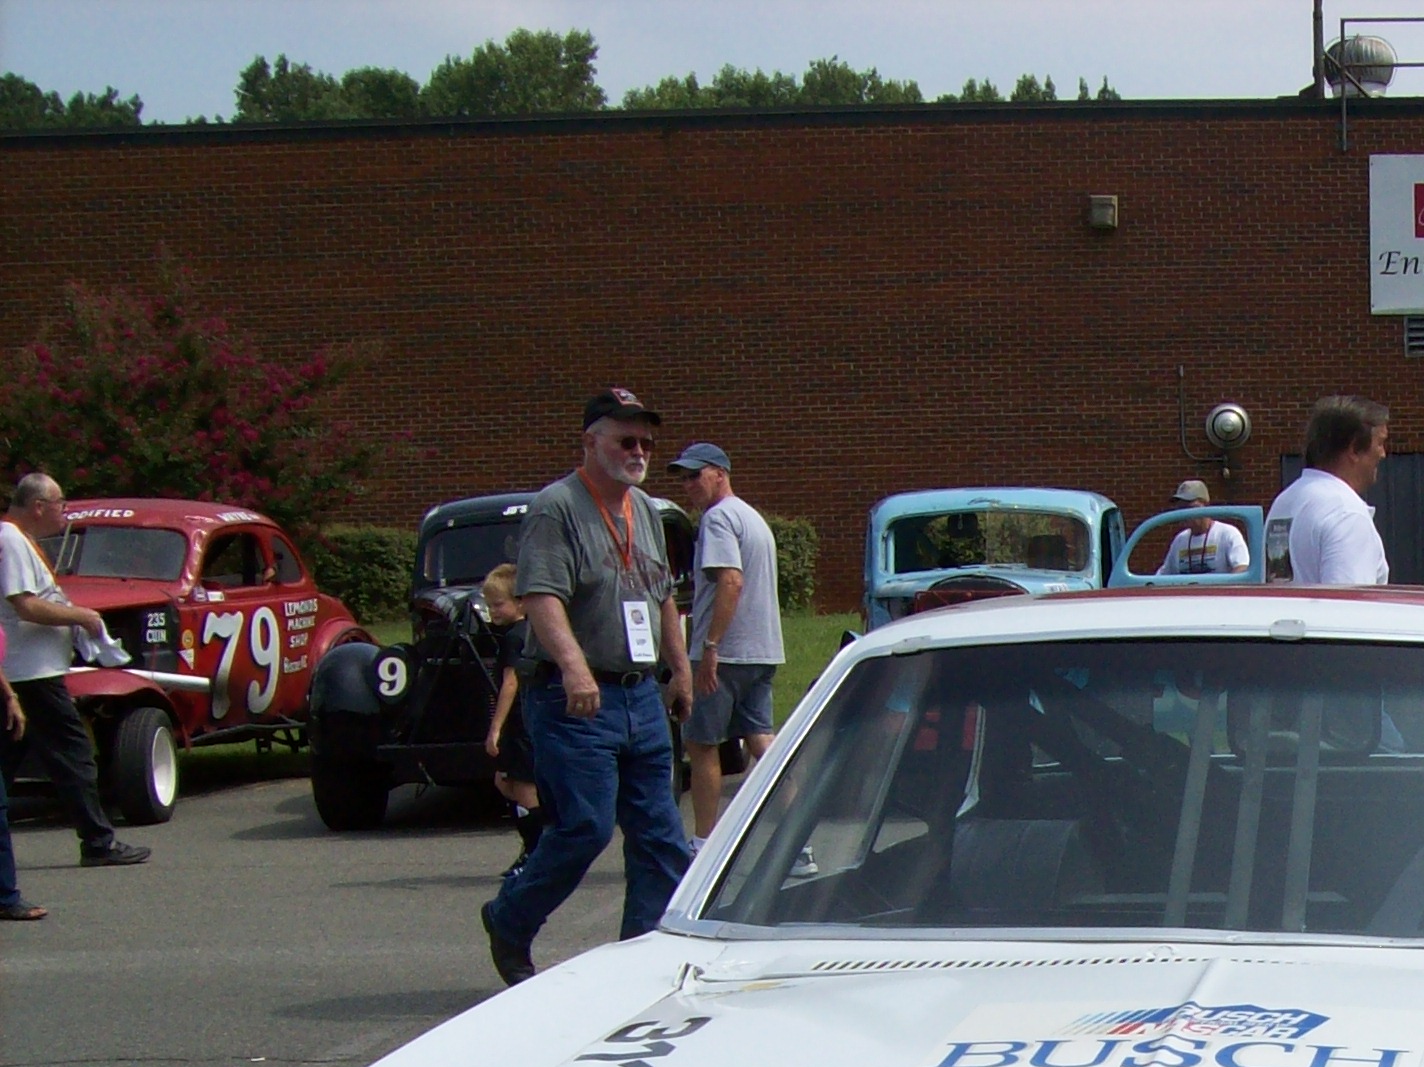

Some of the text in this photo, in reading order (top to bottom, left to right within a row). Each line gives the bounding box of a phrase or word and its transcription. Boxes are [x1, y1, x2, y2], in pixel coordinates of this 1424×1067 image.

[64, 508, 135, 521] ODIFIED
[147, 612, 166, 627] 235
[289, 632, 309, 648] SHOP
[203, 605, 281, 720] 79
[378, 657, 407, 696] 9
[1176, 1005, 1309, 1024] BUSCH
[1143, 1020, 1300, 1039] NASCAR
